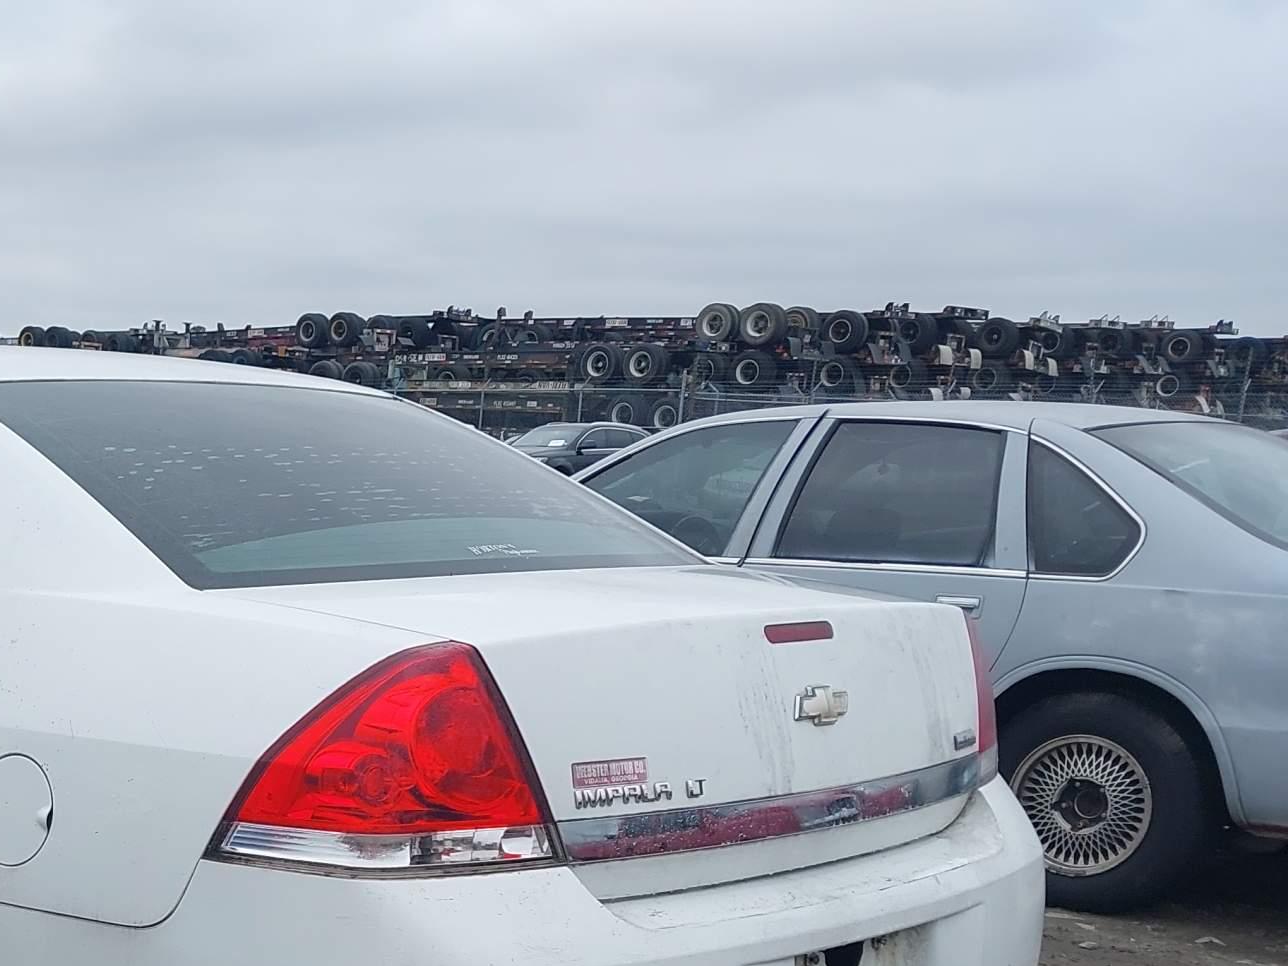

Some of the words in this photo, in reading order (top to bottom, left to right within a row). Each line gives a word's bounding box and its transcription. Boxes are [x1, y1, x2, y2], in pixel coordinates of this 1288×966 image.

[610, 761, 634, 776] MOTOR
[574, 782, 673, 809] IMPALA
[686, 779, 707, 798] LT
